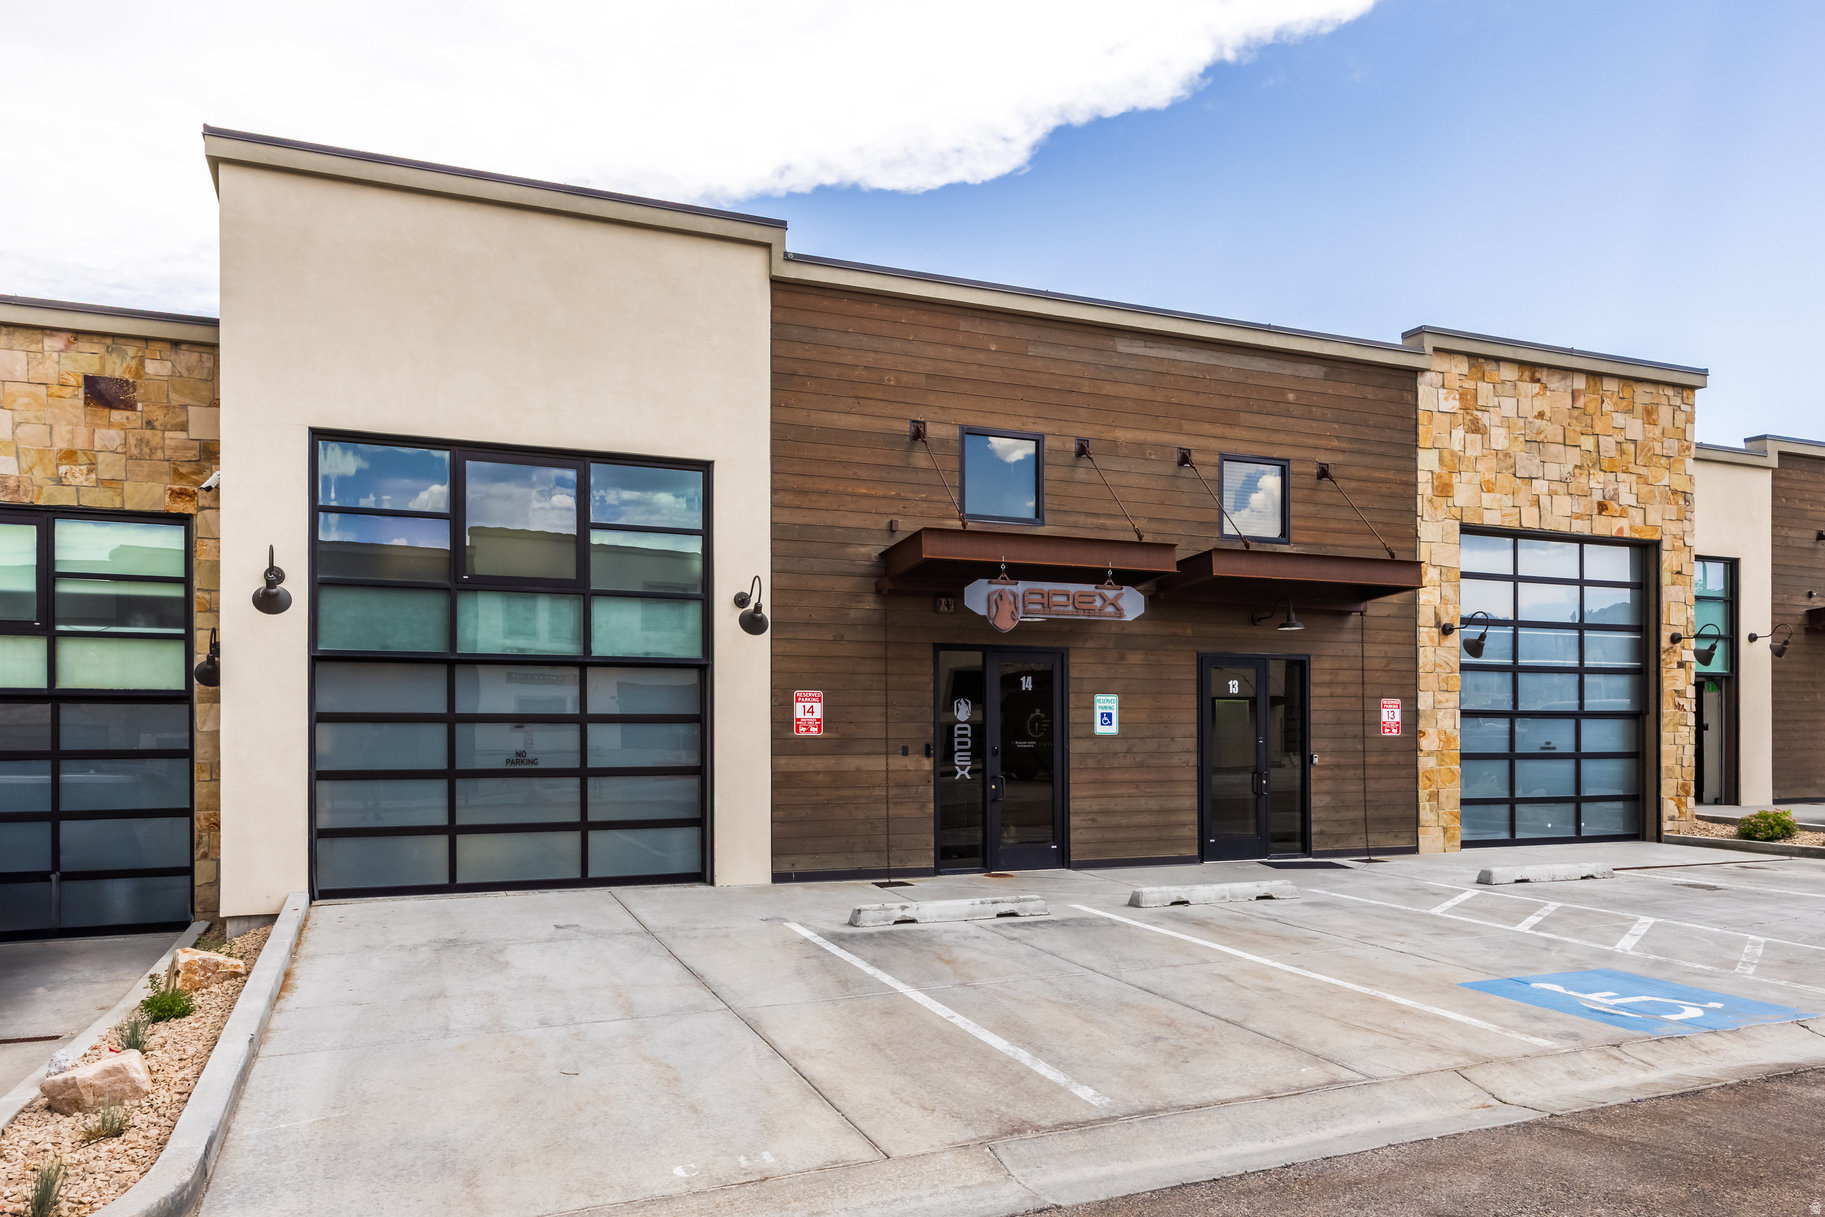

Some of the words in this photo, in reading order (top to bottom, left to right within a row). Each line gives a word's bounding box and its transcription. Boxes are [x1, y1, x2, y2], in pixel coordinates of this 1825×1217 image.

[1023, 588, 1124, 612] APEX
[1021, 676, 1032, 690] 14
[1228, 680, 1239, 693] 13
[802, 704, 815, 717] 14
[1386, 710, 1396, 720] 13
[515, 750, 527, 758] NO
[954, 723, 971, 779] APEX
[505, 758, 539, 767] PARKING
